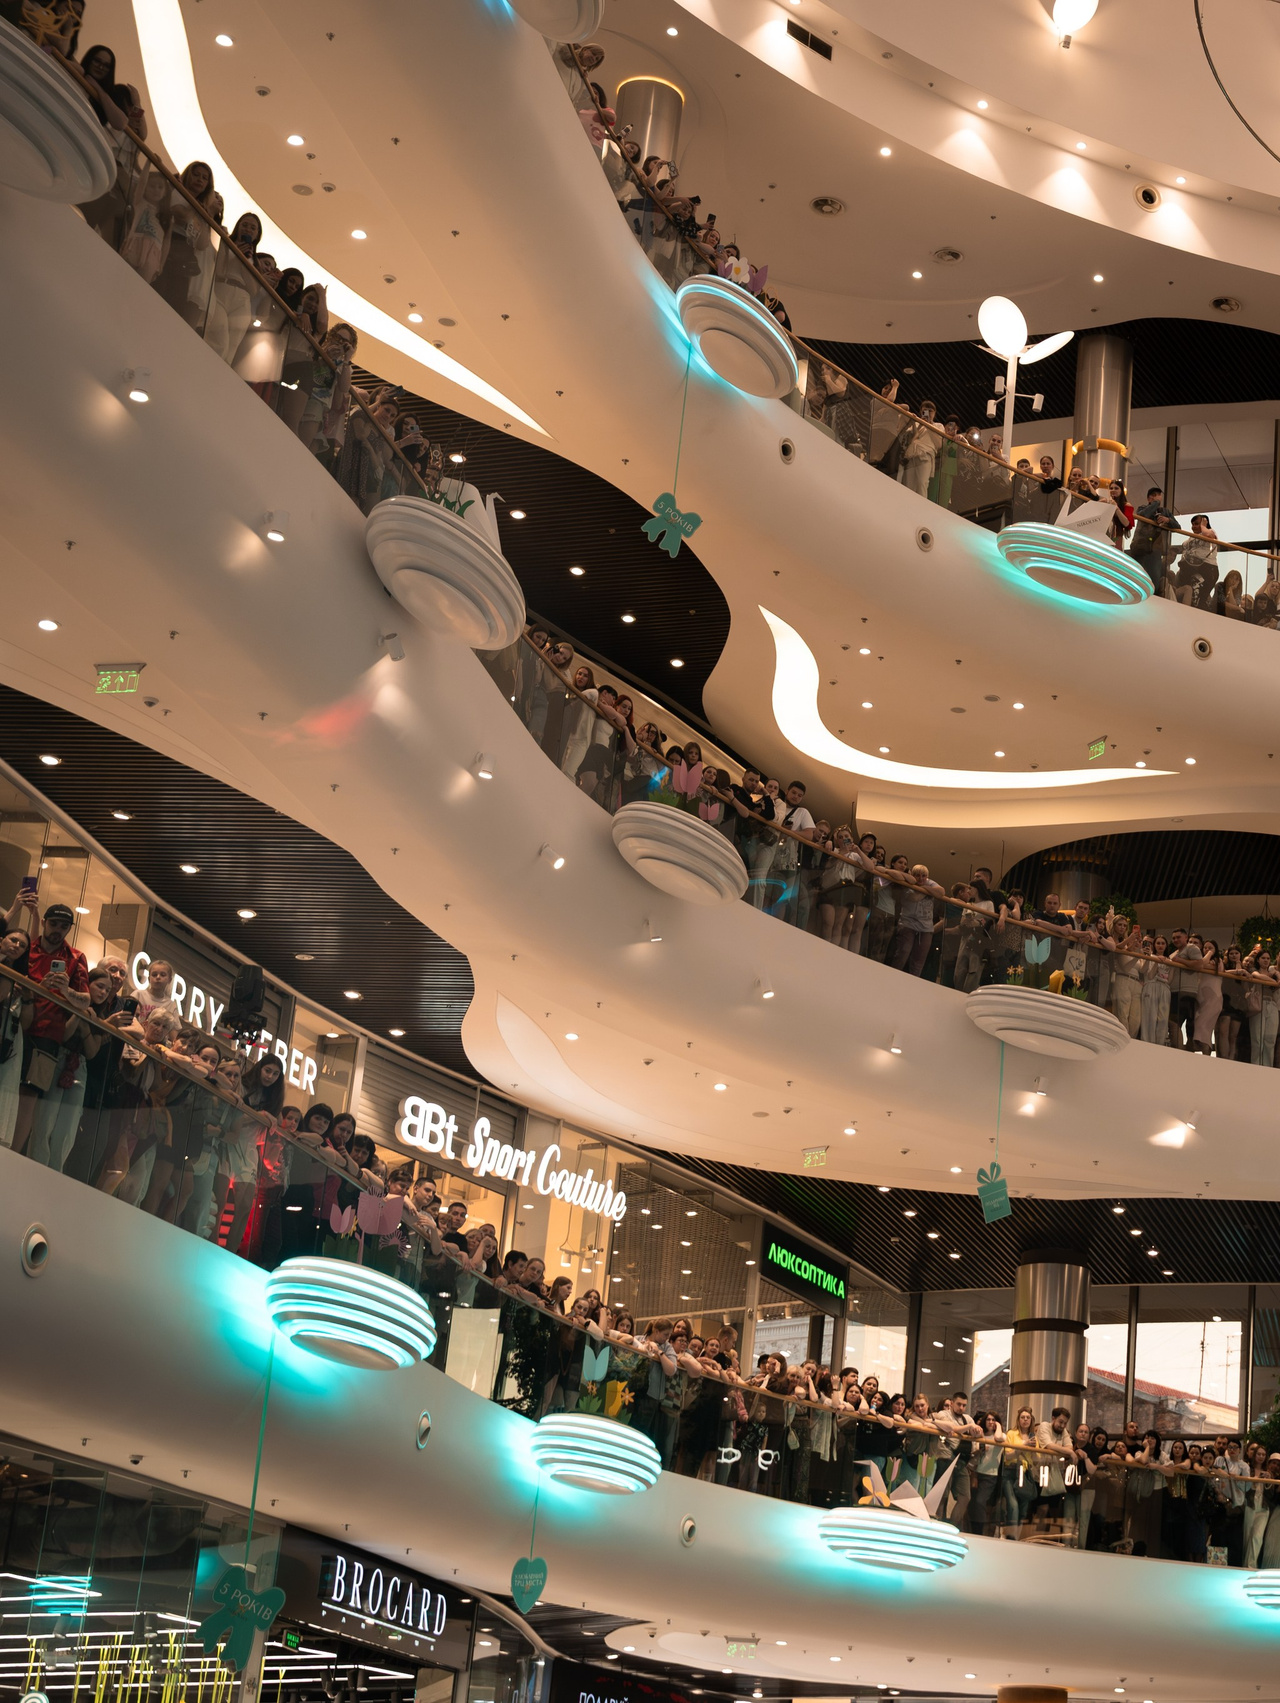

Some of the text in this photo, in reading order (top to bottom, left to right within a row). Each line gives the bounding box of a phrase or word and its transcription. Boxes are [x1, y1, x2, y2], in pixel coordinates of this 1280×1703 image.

[132, 951, 224, 1035] GRRY
[466, 1117, 536, 1186] Sport
[536, 1144, 627, 1221] Couture
[768, 1242, 845, 1299] ЛЮКСОПТИКА
[219, 1583, 273, 1621] 5 РОКІВ
[331, 1555, 447, 1635] BROCARD
